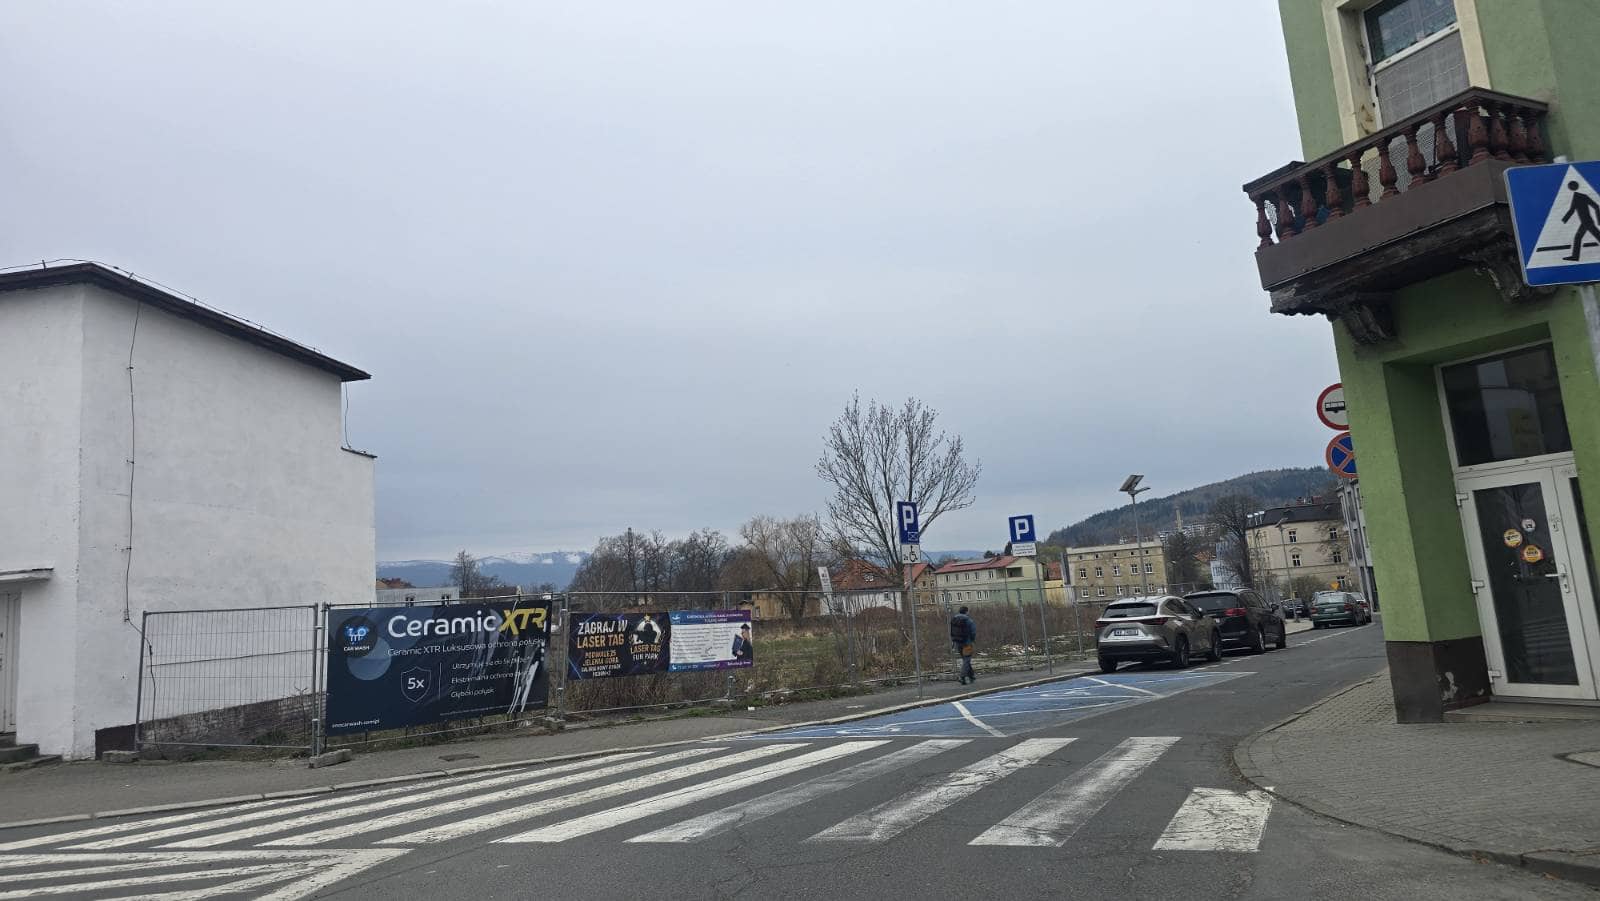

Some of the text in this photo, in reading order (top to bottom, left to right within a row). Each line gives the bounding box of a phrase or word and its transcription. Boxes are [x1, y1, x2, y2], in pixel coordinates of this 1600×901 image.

[902, 505, 914, 531] P
[1014, 518, 1030, 541] P
[387, 607, 547, 638] Ceramic XTR
[577, 620, 628, 635] ZAGRAJ W
[577, 633, 625, 649] LASER TAG
[387, 647, 422, 657] Ceramic
[423, 645, 441, 654] XTR
[630, 645, 651, 654] LASER
[407, 678, 425, 690] 5x
